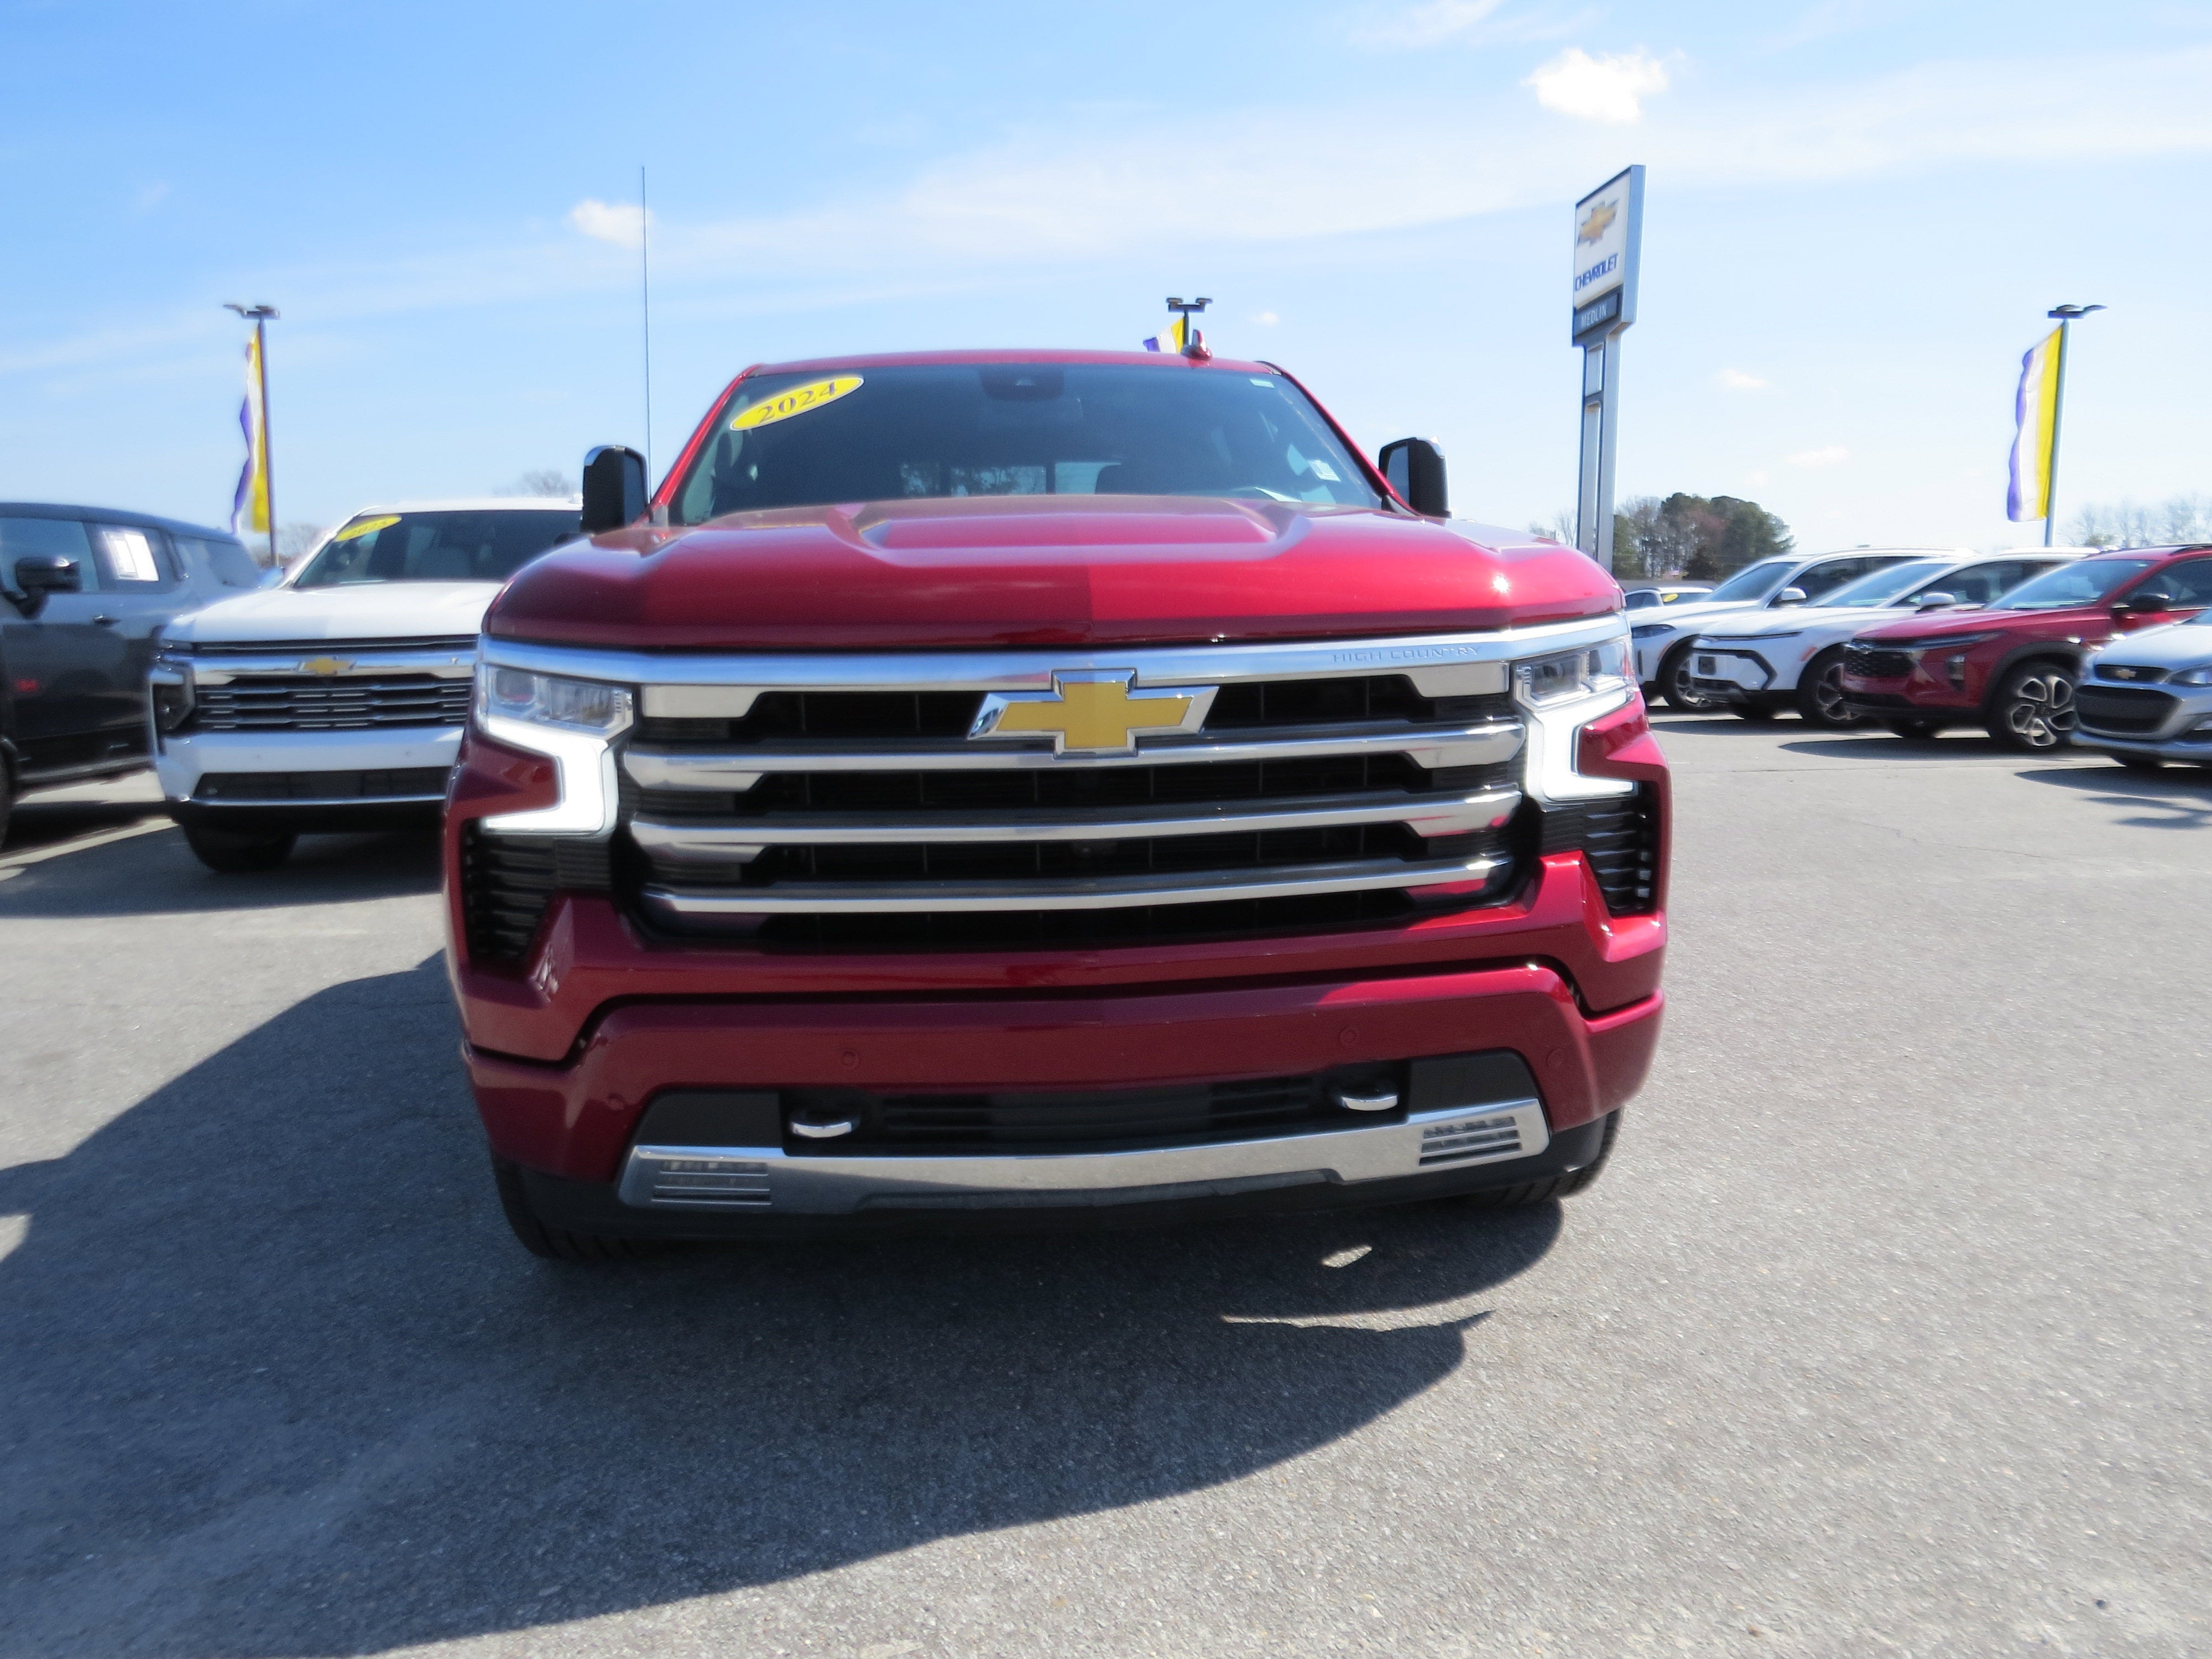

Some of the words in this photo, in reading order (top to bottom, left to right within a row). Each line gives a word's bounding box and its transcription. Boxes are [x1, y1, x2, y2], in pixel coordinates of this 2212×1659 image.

[1575, 254, 1618, 290] CHEVROLET
[757, 381, 838, 424] 2024
[1333, 651, 1381, 662] HIGH
[1390, 646, 1481, 659] COUNTRY
